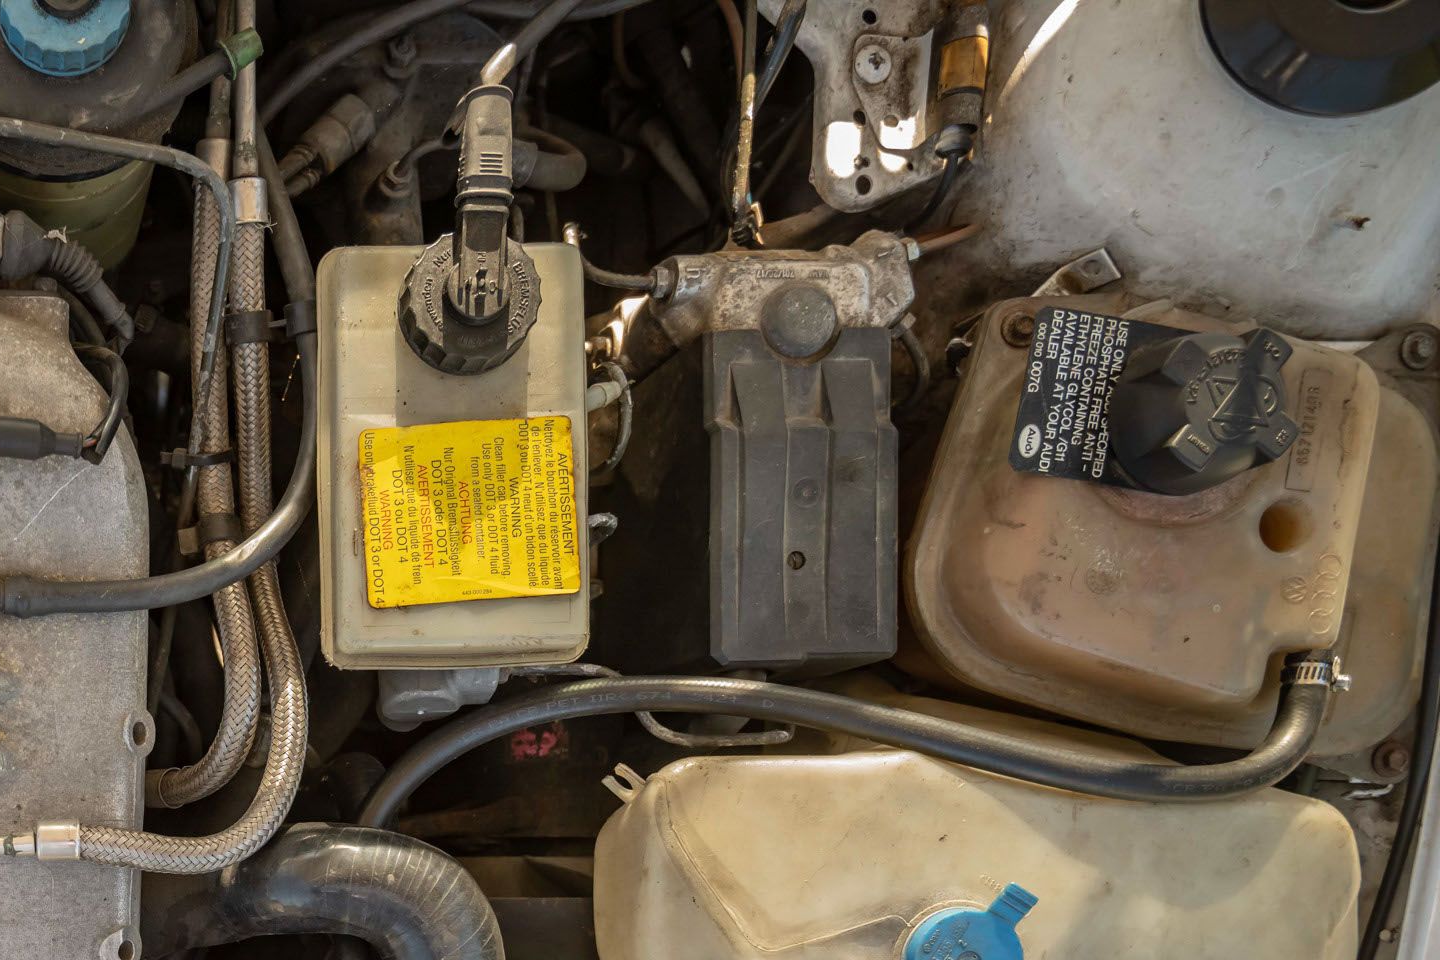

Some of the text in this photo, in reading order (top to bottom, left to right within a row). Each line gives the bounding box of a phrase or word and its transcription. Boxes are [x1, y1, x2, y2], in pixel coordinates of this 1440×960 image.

[433, 249, 453, 269] Nur
[1045, 309, 1064, 359] DEALER
[1069, 313, 1091, 379] ETHYLENE
[1115, 320, 1129, 346] USE
[1026, 322, 1047, 393] 000 010 007G
[1093, 318, 1116, 395] PHOSPHATE
[1108, 348, 1124, 383] ONLY
[1038, 311, 1077, 472] AVAILABLE AT YOUR AUDI
[1070, 316, 1103, 445] FREEZE CONTAINING
[1059, 382, 1078, 434] GLYCOL
[1086, 397, 1102, 431] FREE
[364, 432, 375, 449] Use
[518, 423, 529, 441] DOT
[530, 426, 540, 436] de
[541, 419, 556, 457] Nettoyez
[1023, 426, 1037, 455] Audi
[443, 447, 454, 463] Nur
[481, 443, 492, 459] Use
[493, 436, 505, 461] Clean
[520, 452, 528, 462] ou
[1080, 432, 1095, 460] ANTI
[1090, 417, 1111, 478] SPECIFIED
[431, 459, 442, 485] DOT
[470, 456, 481, 477] from
[481, 462, 493, 480] only
[495, 463, 506, 483] filler
[520, 465, 532, 483] DOT
[391, 469, 403, 494] DOT
[443, 465, 457, 499] Original
[484, 483, 495, 502] DOT
[494, 485, 505, 500] cap
[546, 470, 558, 508] bouchon
[433, 499, 445, 525] oder
[458, 481, 472, 544] ACHTUNG
[472, 487, 483, 515] sealed
[508, 477, 522, 537] WARNING
[522, 493, 533, 512] neuf
[534, 482, 546, 520] N'utilisez
[557, 452, 573, 555] AVERTISSEMENT
[379, 489, 393, 549] WARNING
[394, 509, 402, 523] ou
[403, 445, 423, 584] N'utilisez que du liquide de frein
[417, 464, 434, 568] AVERTISSEMENT
[486, 513, 495, 522] or
[498, 504, 509, 531] before
[549, 511, 558, 522] du
[369, 517, 380, 543] DOT
[396, 527, 407, 552] DOT
[435, 529, 447, 554] DOT
[487, 525, 498, 544] DOT
[535, 524, 546, 540] que
[525, 535, 536, 560] bidon
[538, 542, 548, 553] du
[550, 525, 562, 563] réservoir
[371, 555, 379, 566] or
[489, 555, 500, 574] fluid
[537, 556, 550, 585] liquide
[373, 569, 384, 595] DOT
[552, 566, 563, 589] avant
